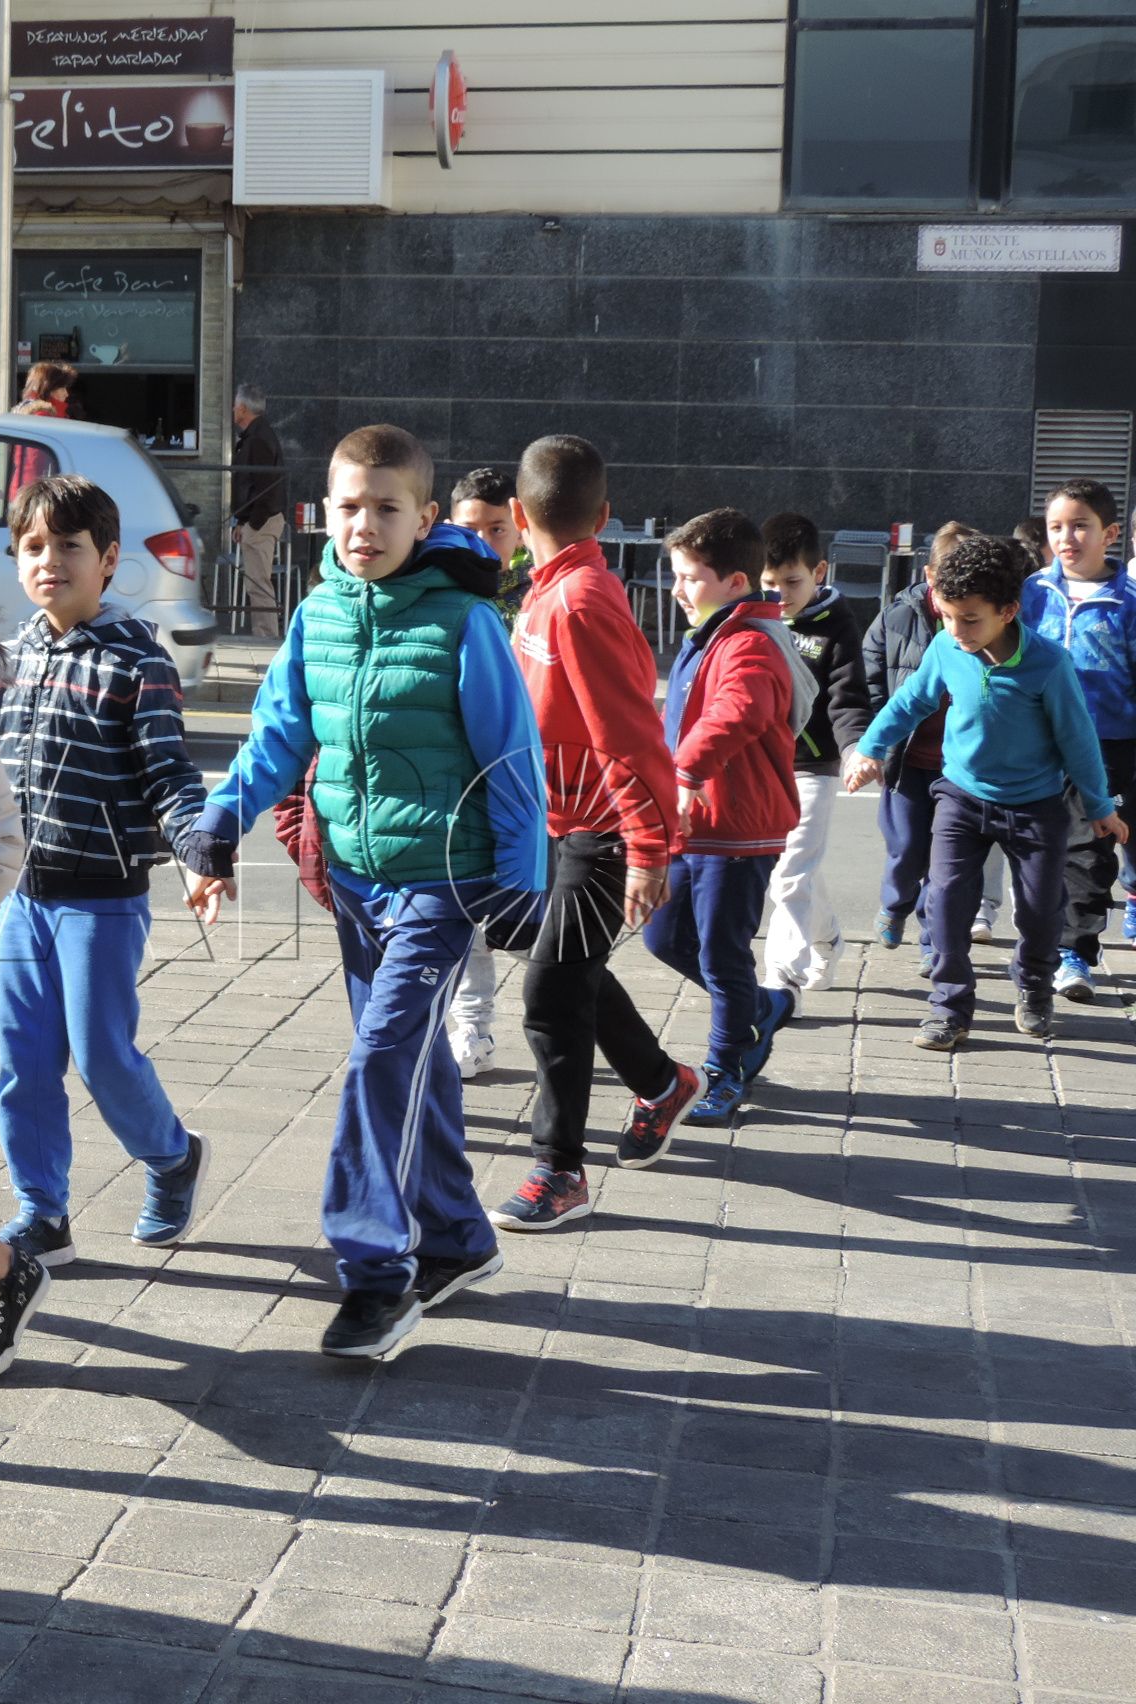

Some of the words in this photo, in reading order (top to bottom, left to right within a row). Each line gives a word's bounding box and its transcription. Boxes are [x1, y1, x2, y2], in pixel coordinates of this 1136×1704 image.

[113, 26, 209, 43] MERIENDAS
[51, 53, 103, 68] TAPAS
[105, 50, 183, 67] VARIADAS
[950, 234, 1021, 247] TENIENTE
[949, 248, 1003, 261] MUÑOZ
[1008, 248, 1108, 262] CASTELLANOS
[113, 270, 175, 297] Bar
